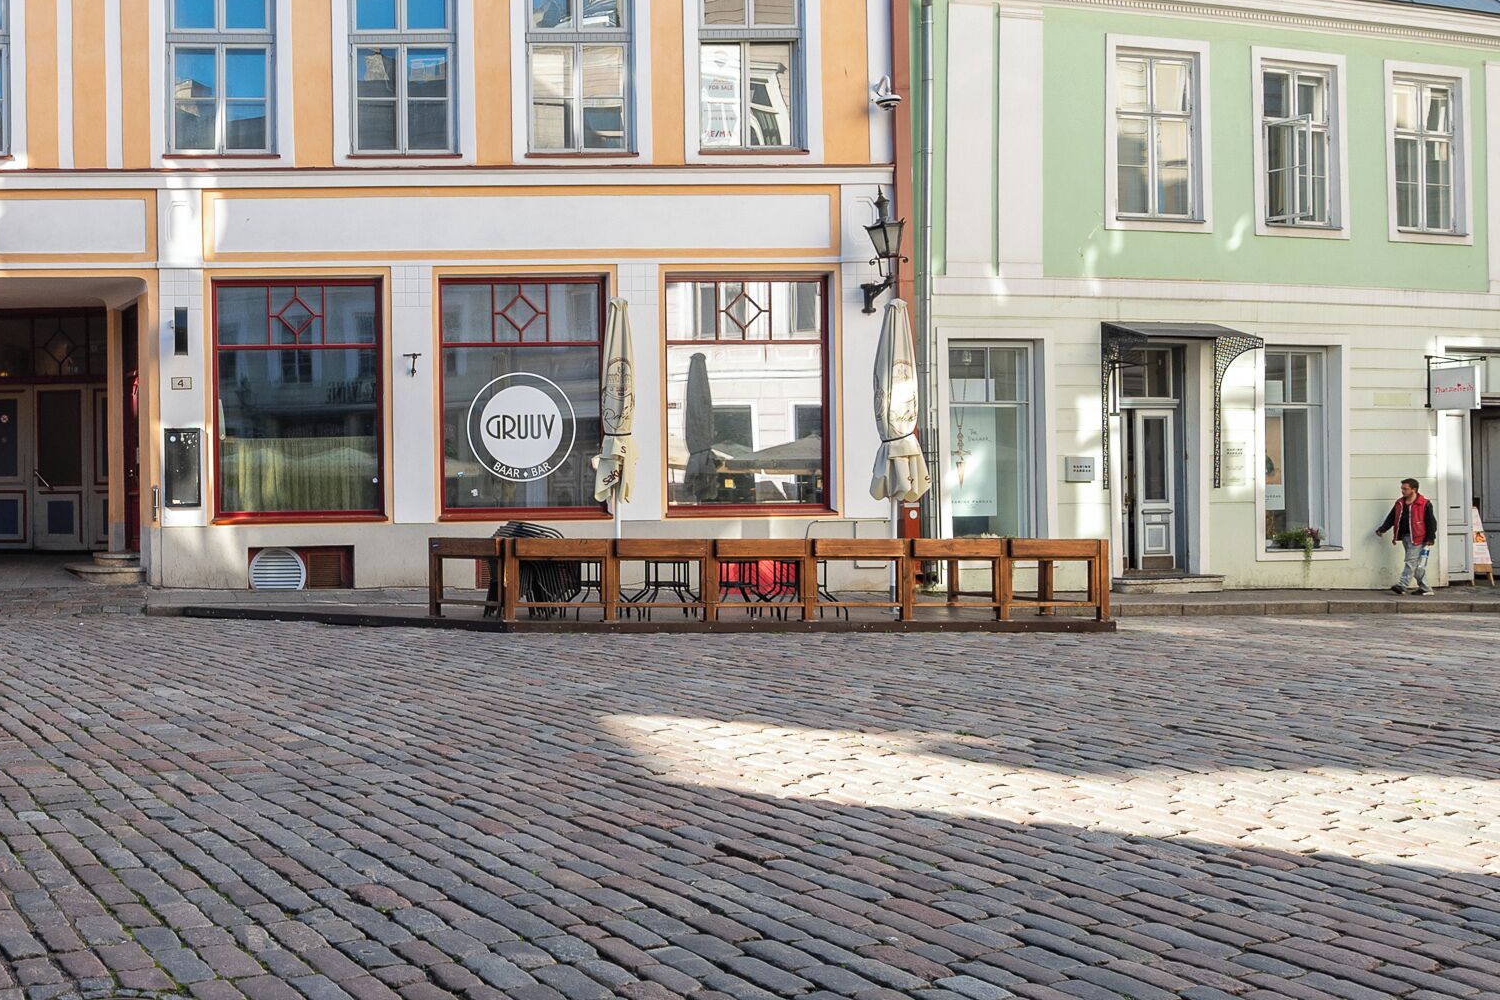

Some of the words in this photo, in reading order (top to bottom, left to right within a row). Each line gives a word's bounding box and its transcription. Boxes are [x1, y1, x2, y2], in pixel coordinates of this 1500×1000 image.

[177, 379, 184, 388] 4
[486, 414, 556, 440] GRUUV
[493, 462, 521, 479] BAAR
[530, 462, 552, 477] BAR
